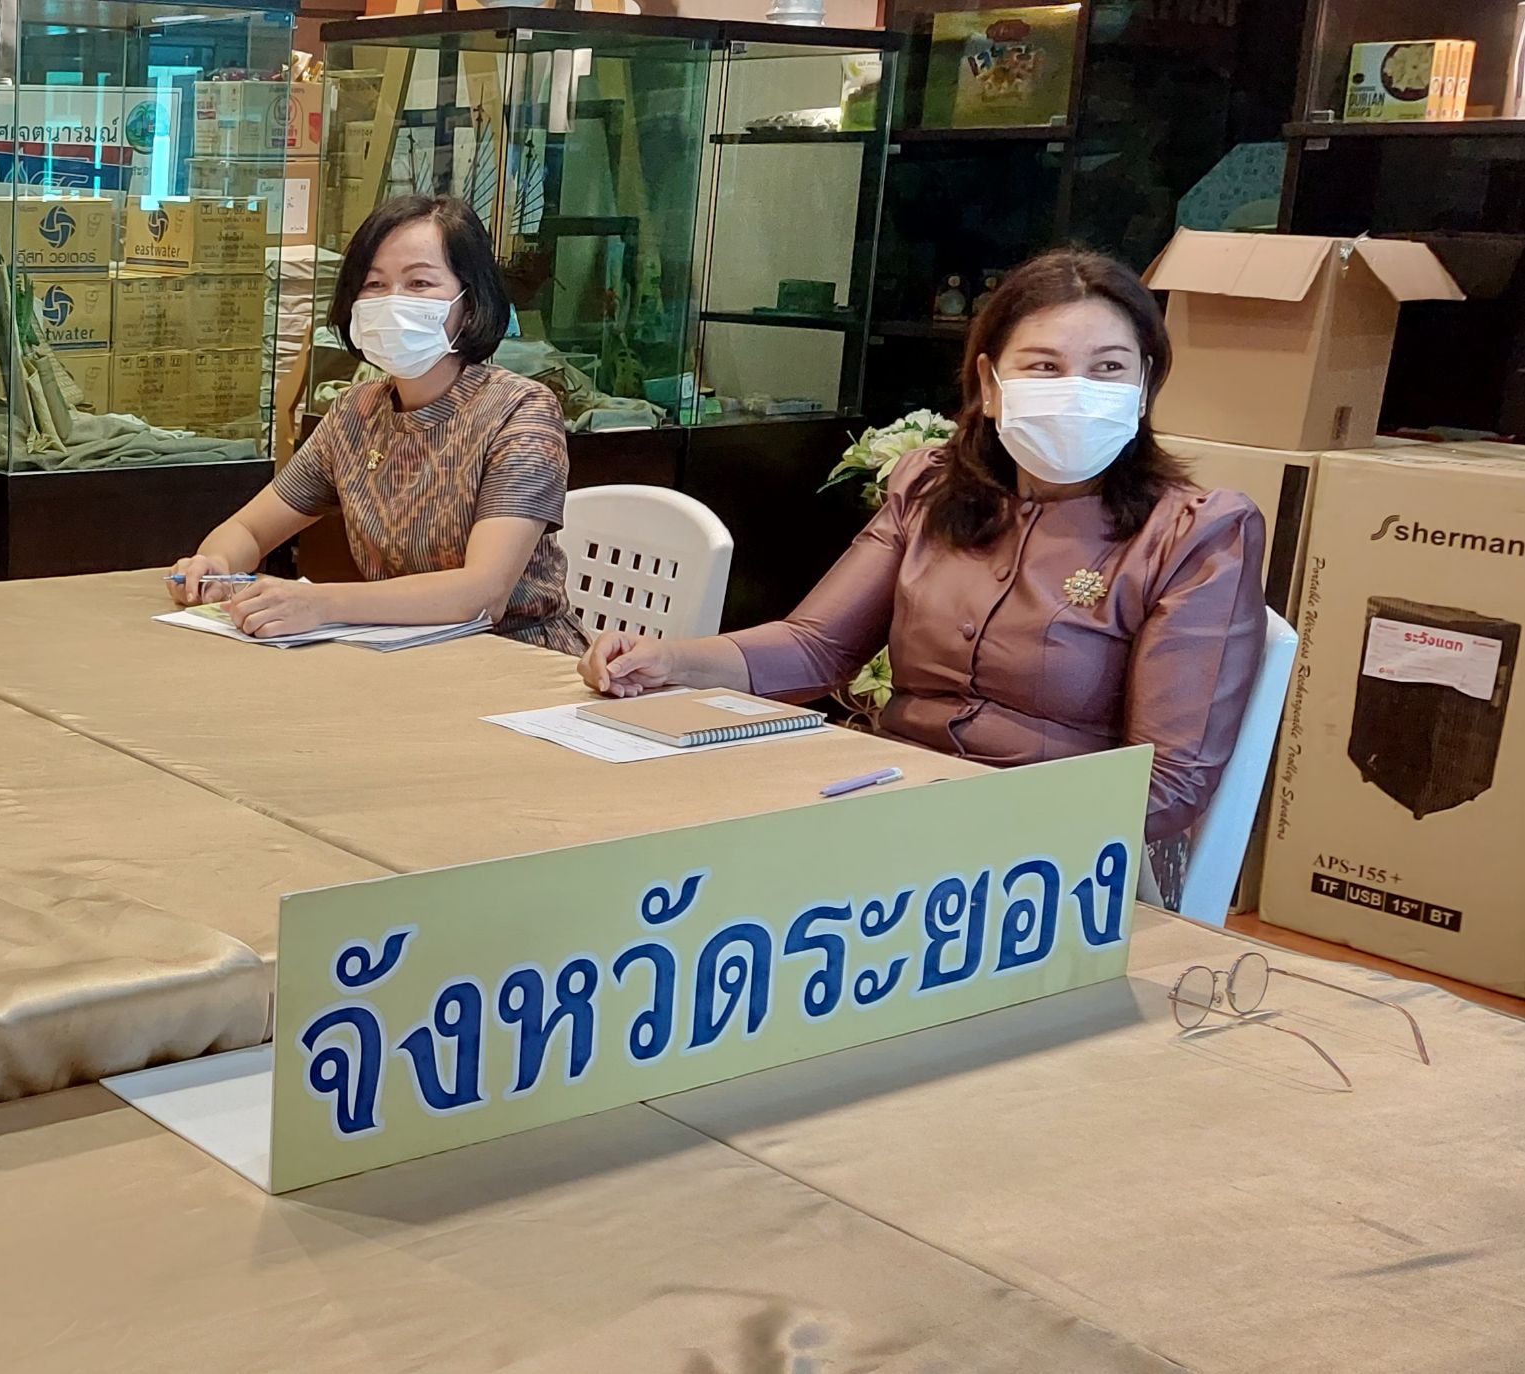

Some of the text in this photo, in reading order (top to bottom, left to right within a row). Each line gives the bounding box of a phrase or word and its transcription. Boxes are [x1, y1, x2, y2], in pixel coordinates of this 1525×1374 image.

[134, 242, 180, 258] eastwater
[45, 326, 95, 341] twater
[1393, 521, 1525, 557] sherman
[1308, 556, 1326, 607] Portable
[1300, 610, 1318, 659] Wireless
[1404, 631, 1464, 652] ระวังแตก
[1290, 663, 1311, 739] Rechargeable
[1282, 744, 1302, 784] Trolley
[1320, 878, 1454, 926] TF USB 15" BT
[300, 840, 1132, 1135] จังหวัดระยอง
